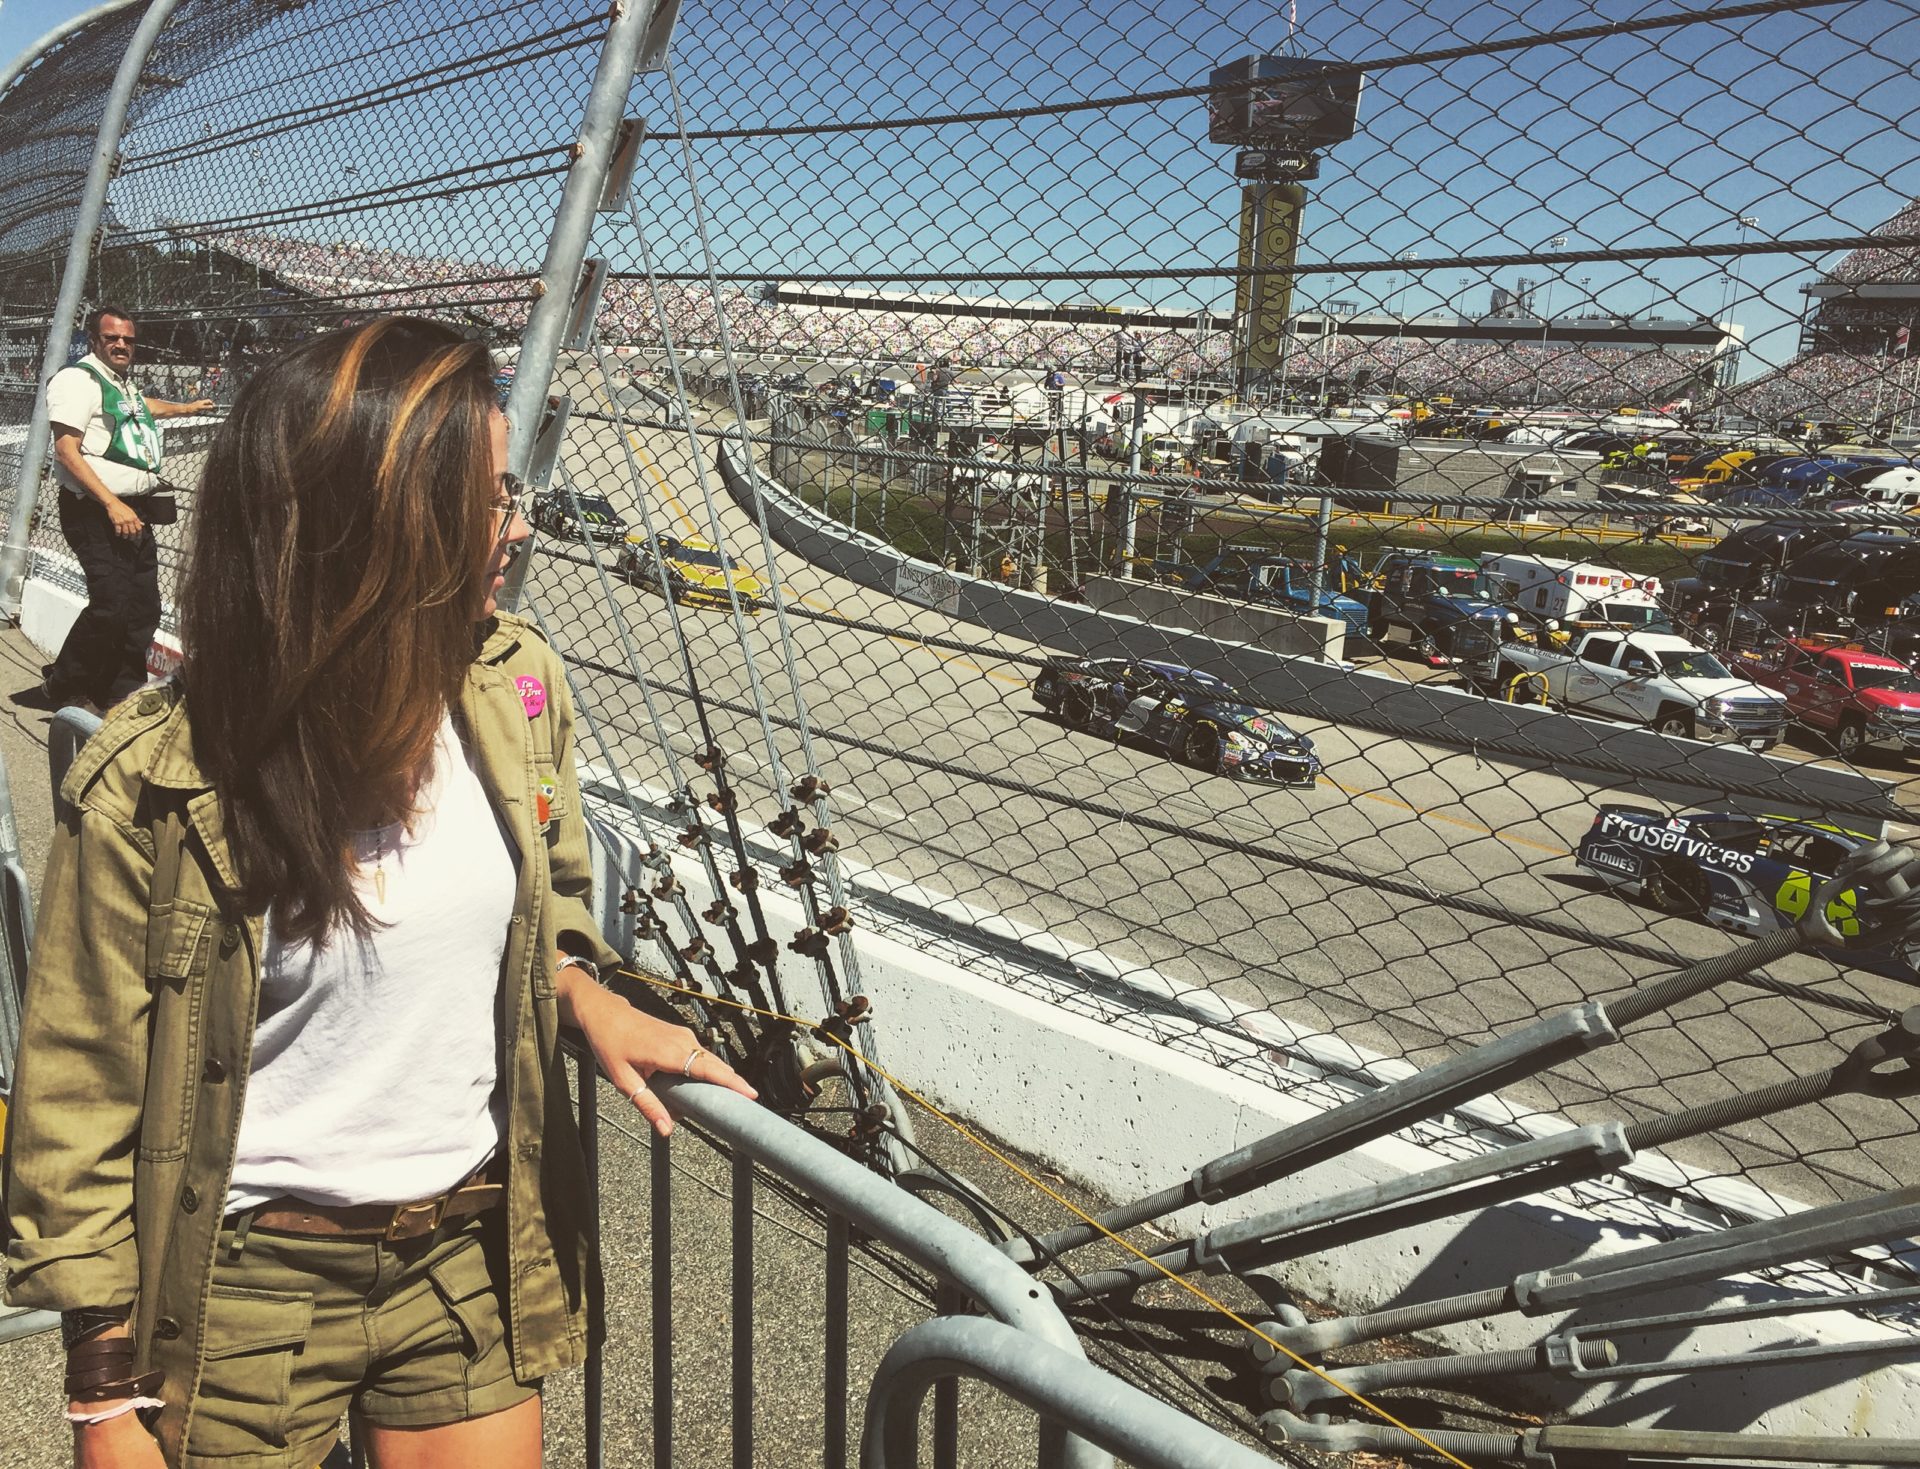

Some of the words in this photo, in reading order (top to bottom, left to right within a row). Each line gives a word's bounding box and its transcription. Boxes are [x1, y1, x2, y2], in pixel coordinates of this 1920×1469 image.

[1276, 157, 1299, 168] Sprint
[932, 575, 956, 595] FANCY
[1553, 598, 1566, 612] 27
[1601, 813, 1755, 874] ProServices
